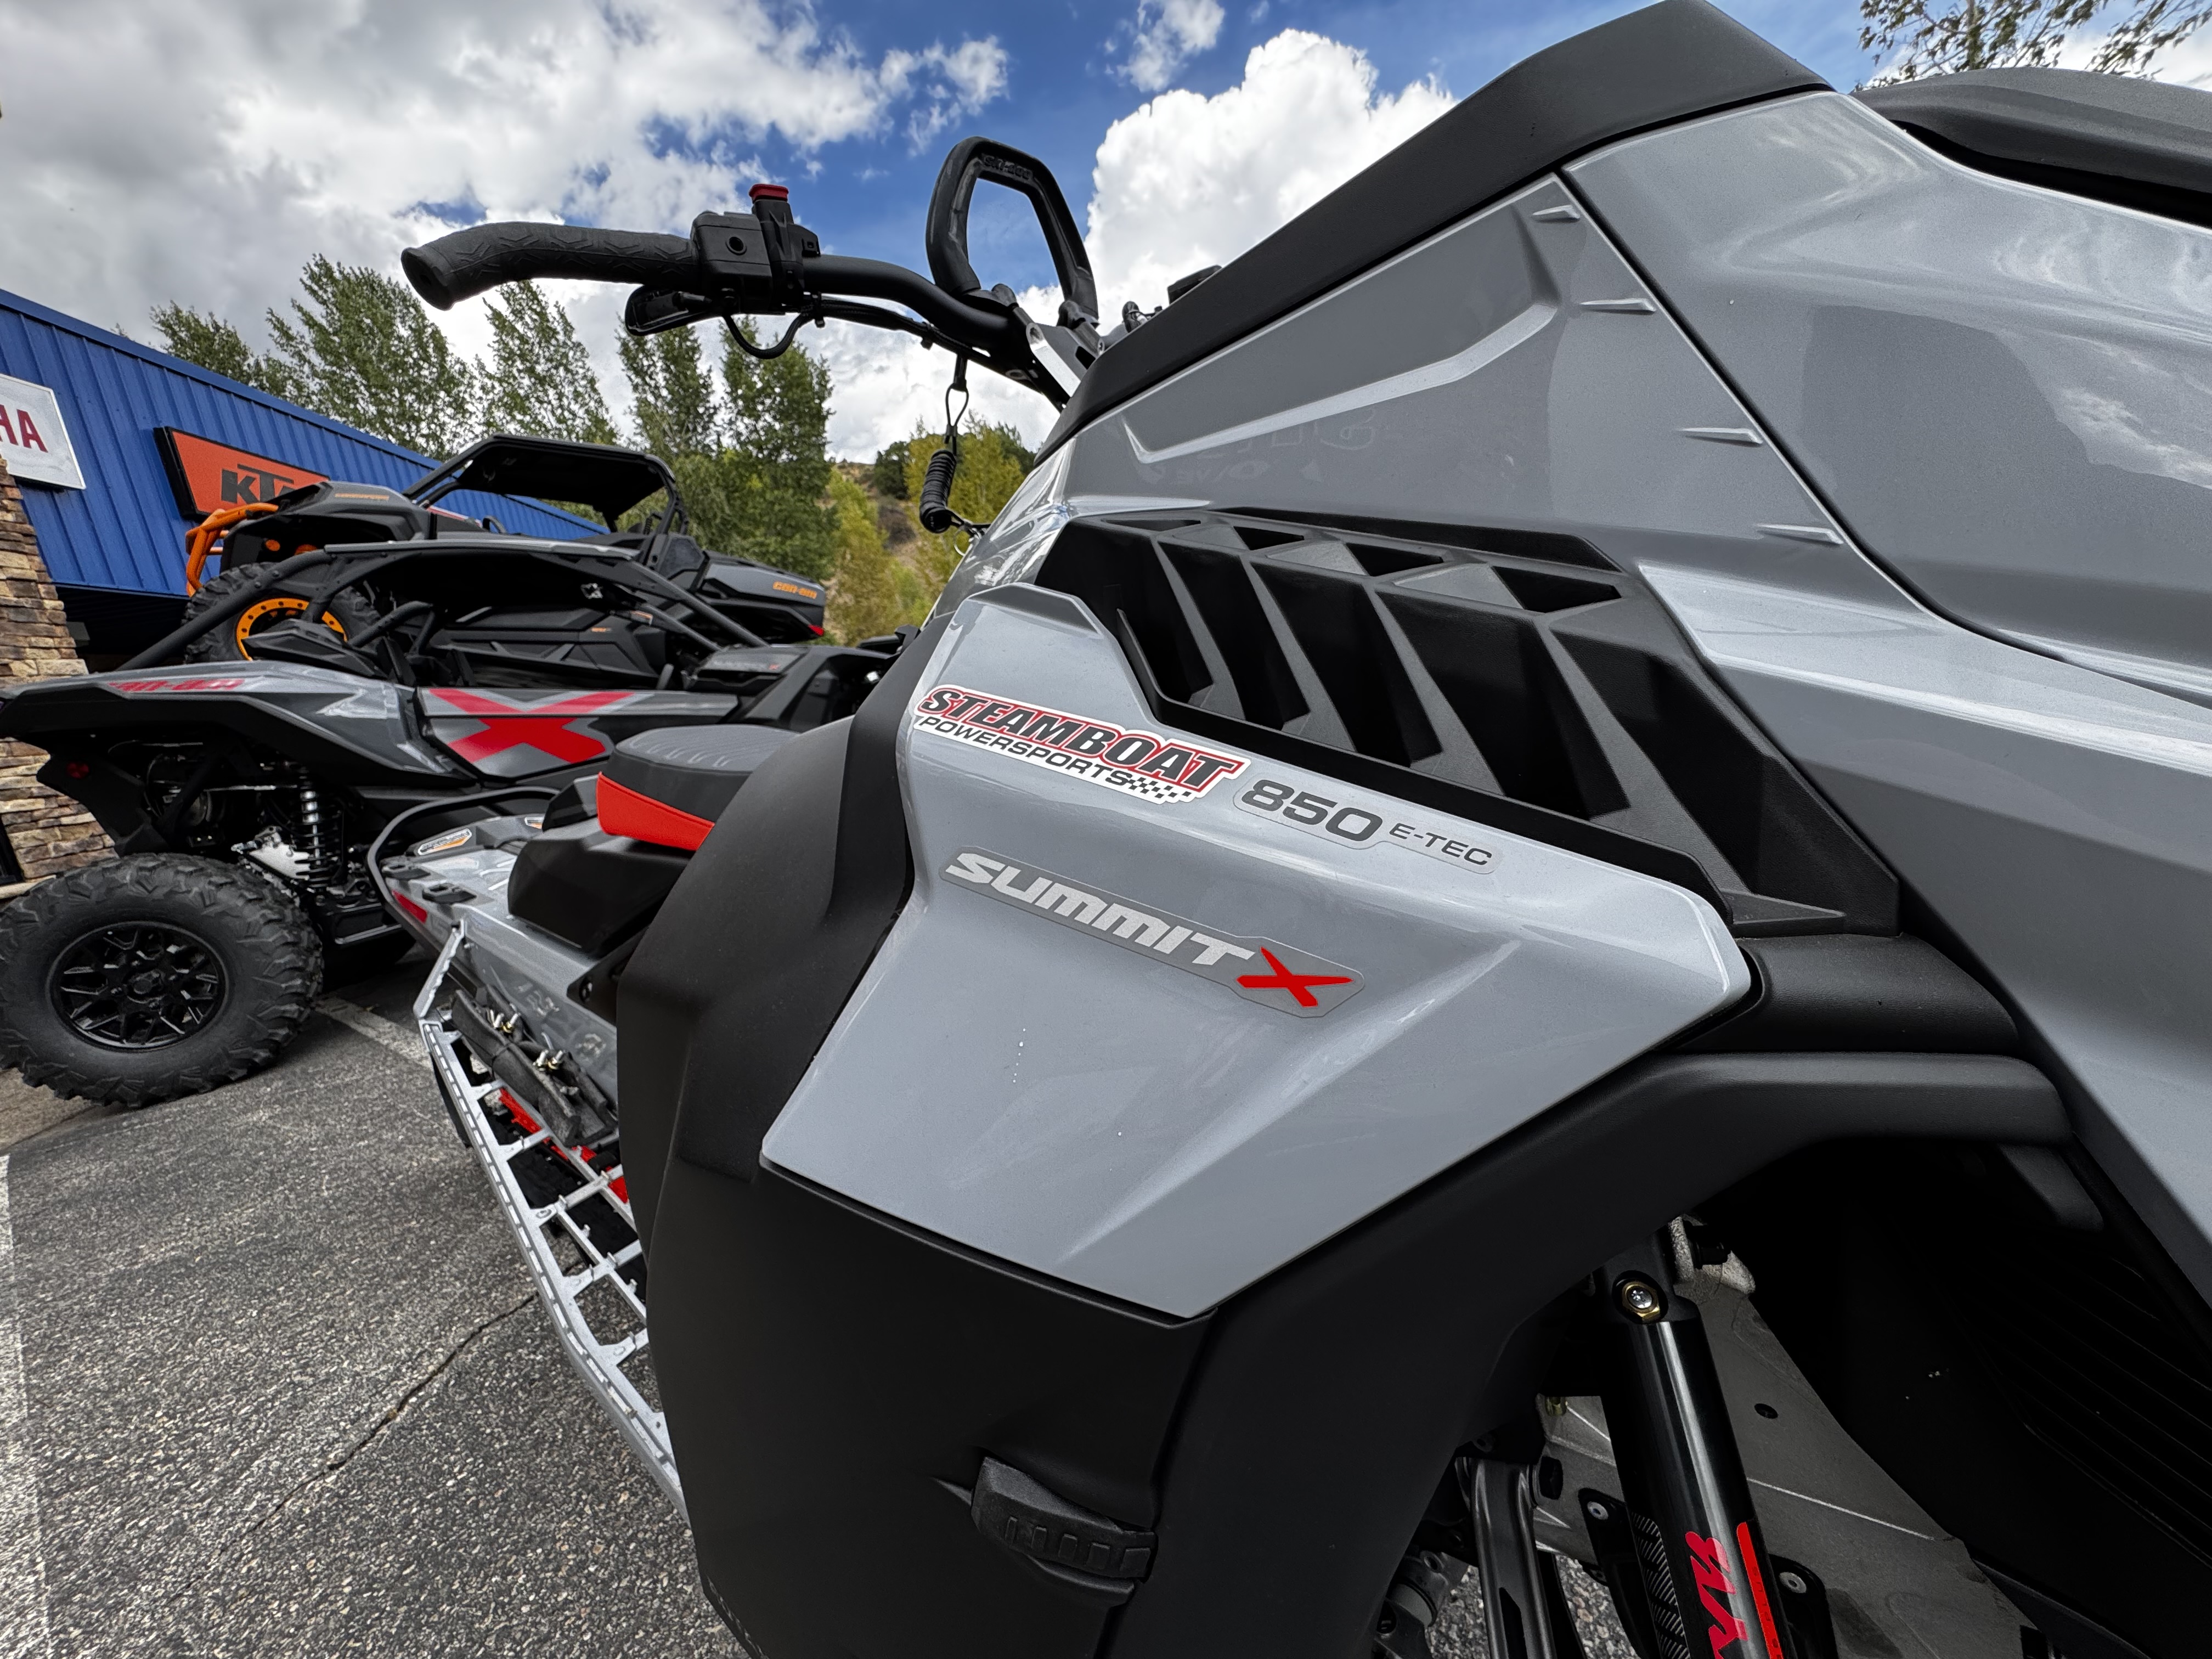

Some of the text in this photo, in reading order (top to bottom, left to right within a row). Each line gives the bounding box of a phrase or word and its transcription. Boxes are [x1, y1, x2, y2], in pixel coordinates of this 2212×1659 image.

[919, 716, 1132, 786] POWERSPORTS
[921, 690, 1235, 788] STEAMBOAT
[1242, 780, 1492, 865] 850 E-TEC
[945, 853, 1353, 1007] SUMMIT X
